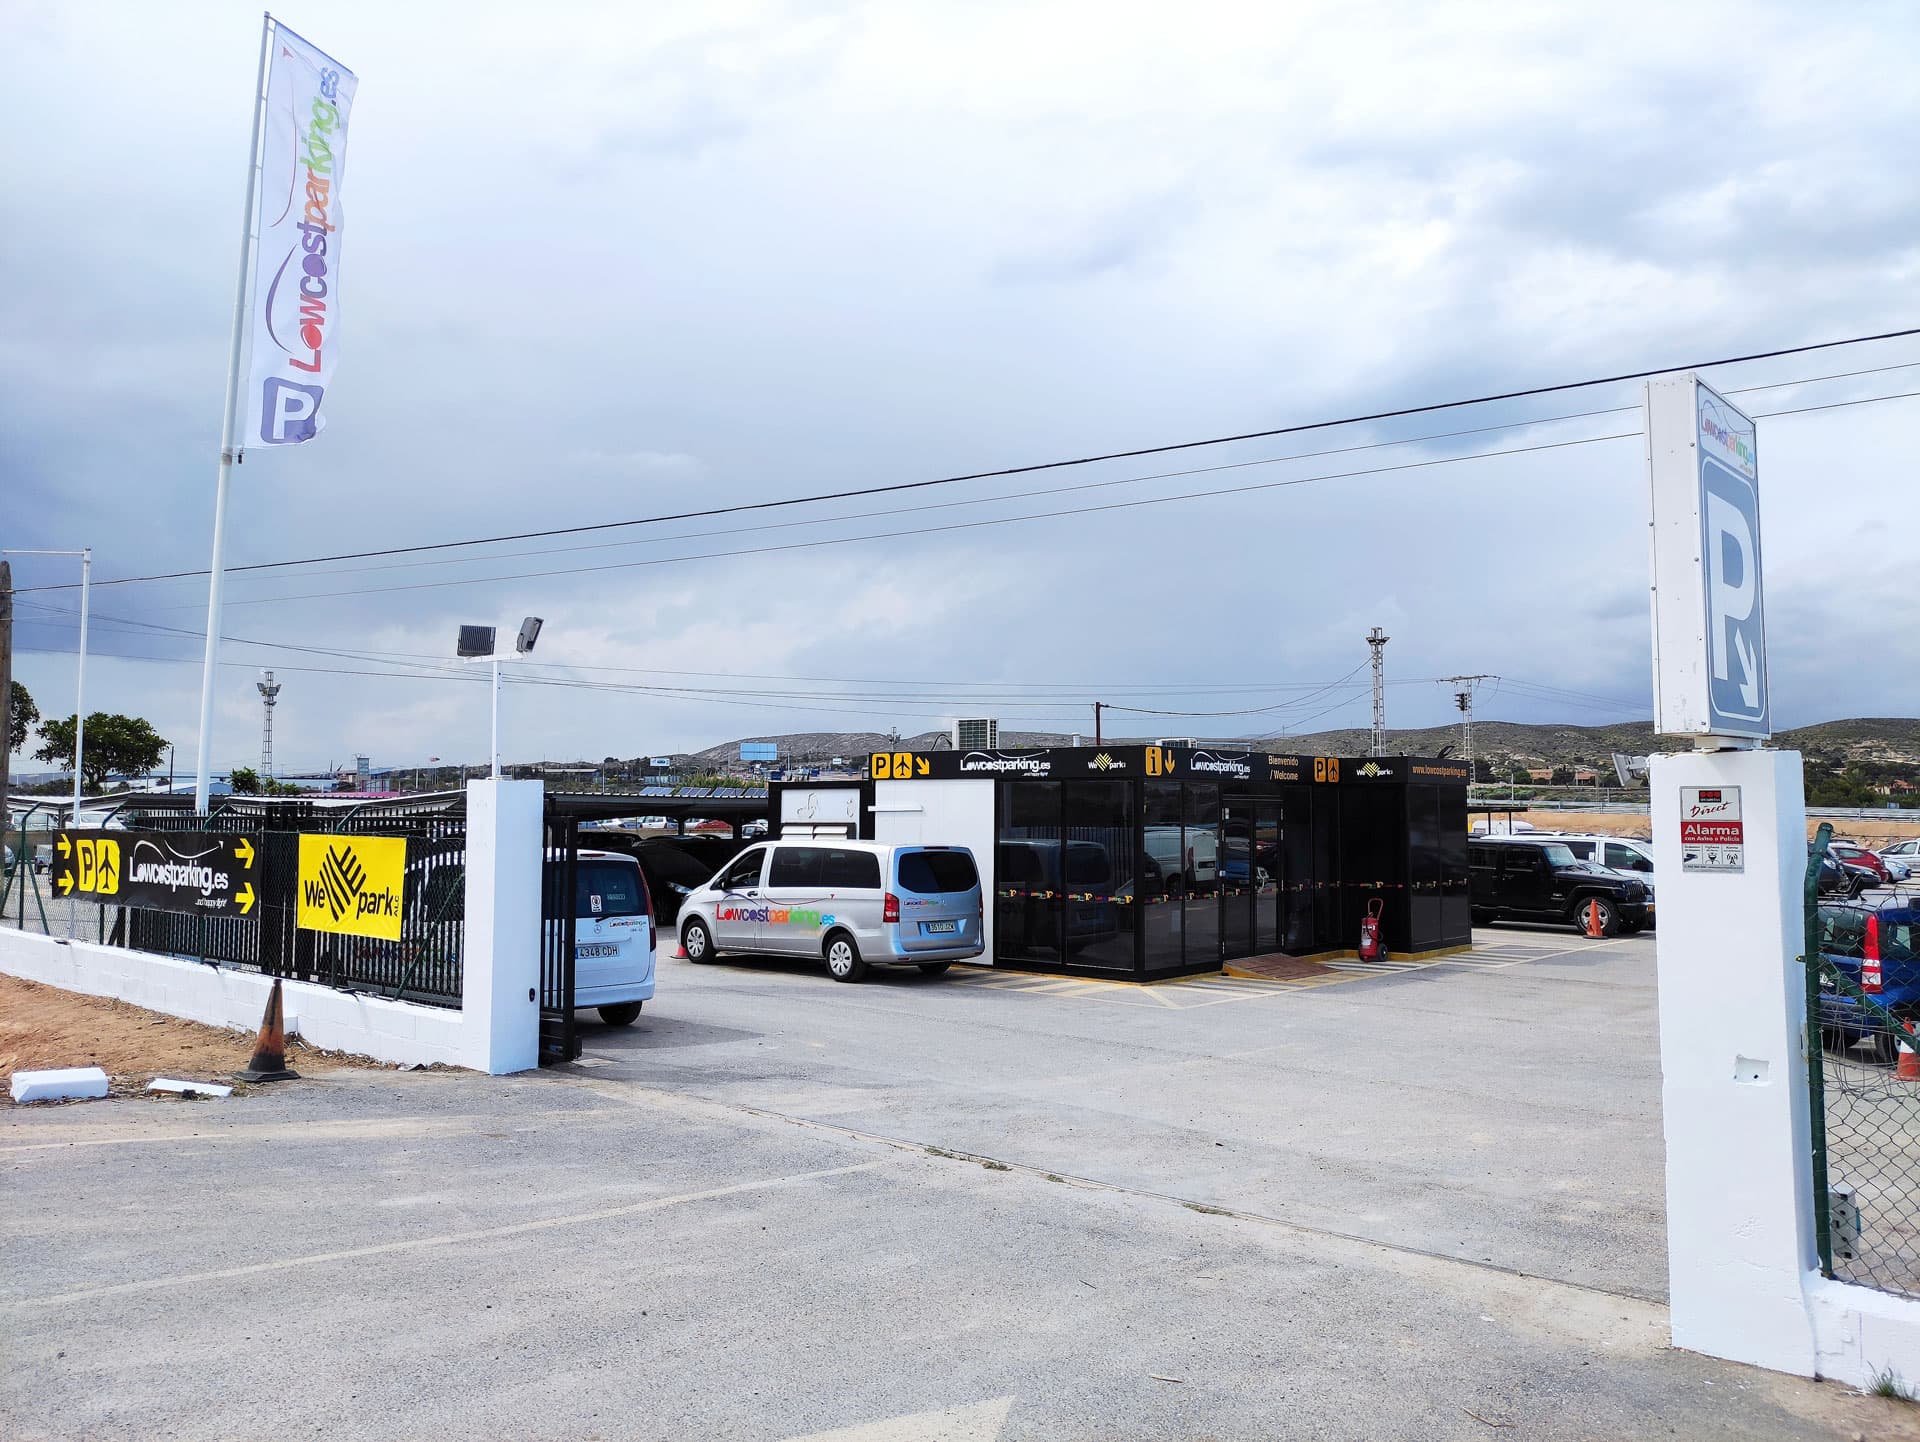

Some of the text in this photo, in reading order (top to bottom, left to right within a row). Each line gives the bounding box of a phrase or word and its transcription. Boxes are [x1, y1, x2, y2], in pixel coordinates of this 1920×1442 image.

[289, 67, 340, 372] Lowcostparking.es
[272, 385, 315, 440] P
[1707, 491, 1756, 681] P
[876, 756, 887, 775] P
[960, 758, 1051, 773] Lowcostparking.es
[1190, 758, 1251, 775] Lowcostparking.es
[1268, 755, 1299, 766] Bienvenido
[1412, 765, 1467, 778] www.lowcostparking.es
[1274, 770, 1299, 780] Welcome
[1684, 824, 1740, 835] Alarma
[83, 847, 93, 885] P
[129, 856, 229, 896] Lowcostparking.es
[304, 880, 394, 920] We park
[716, 904, 836, 929] Lowcostparking.es
